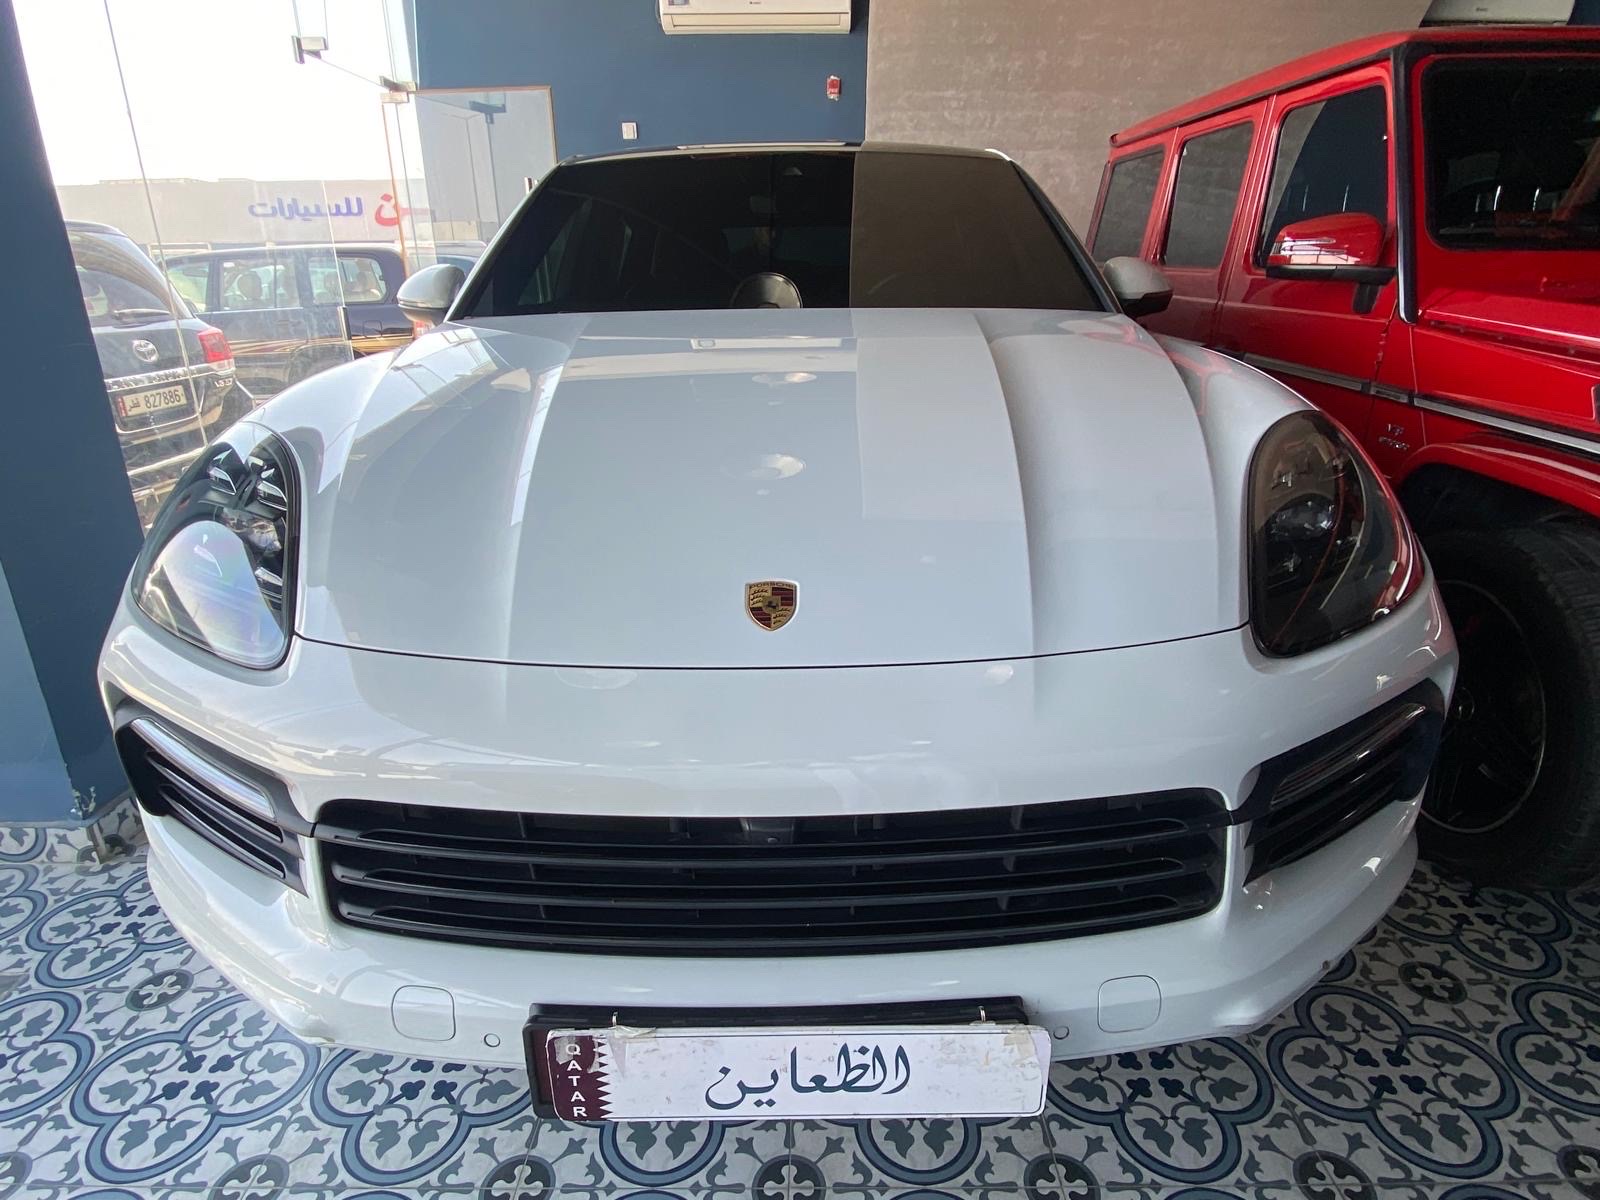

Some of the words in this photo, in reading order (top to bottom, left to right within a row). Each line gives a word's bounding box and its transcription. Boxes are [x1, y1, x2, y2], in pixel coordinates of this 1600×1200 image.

[248, 196, 364, 222] للسيارات
[144, 389, 181, 409] 827886
[565, 1043, 588, 1118] QATAR
[704, 1042, 911, 1111] الظعاين
